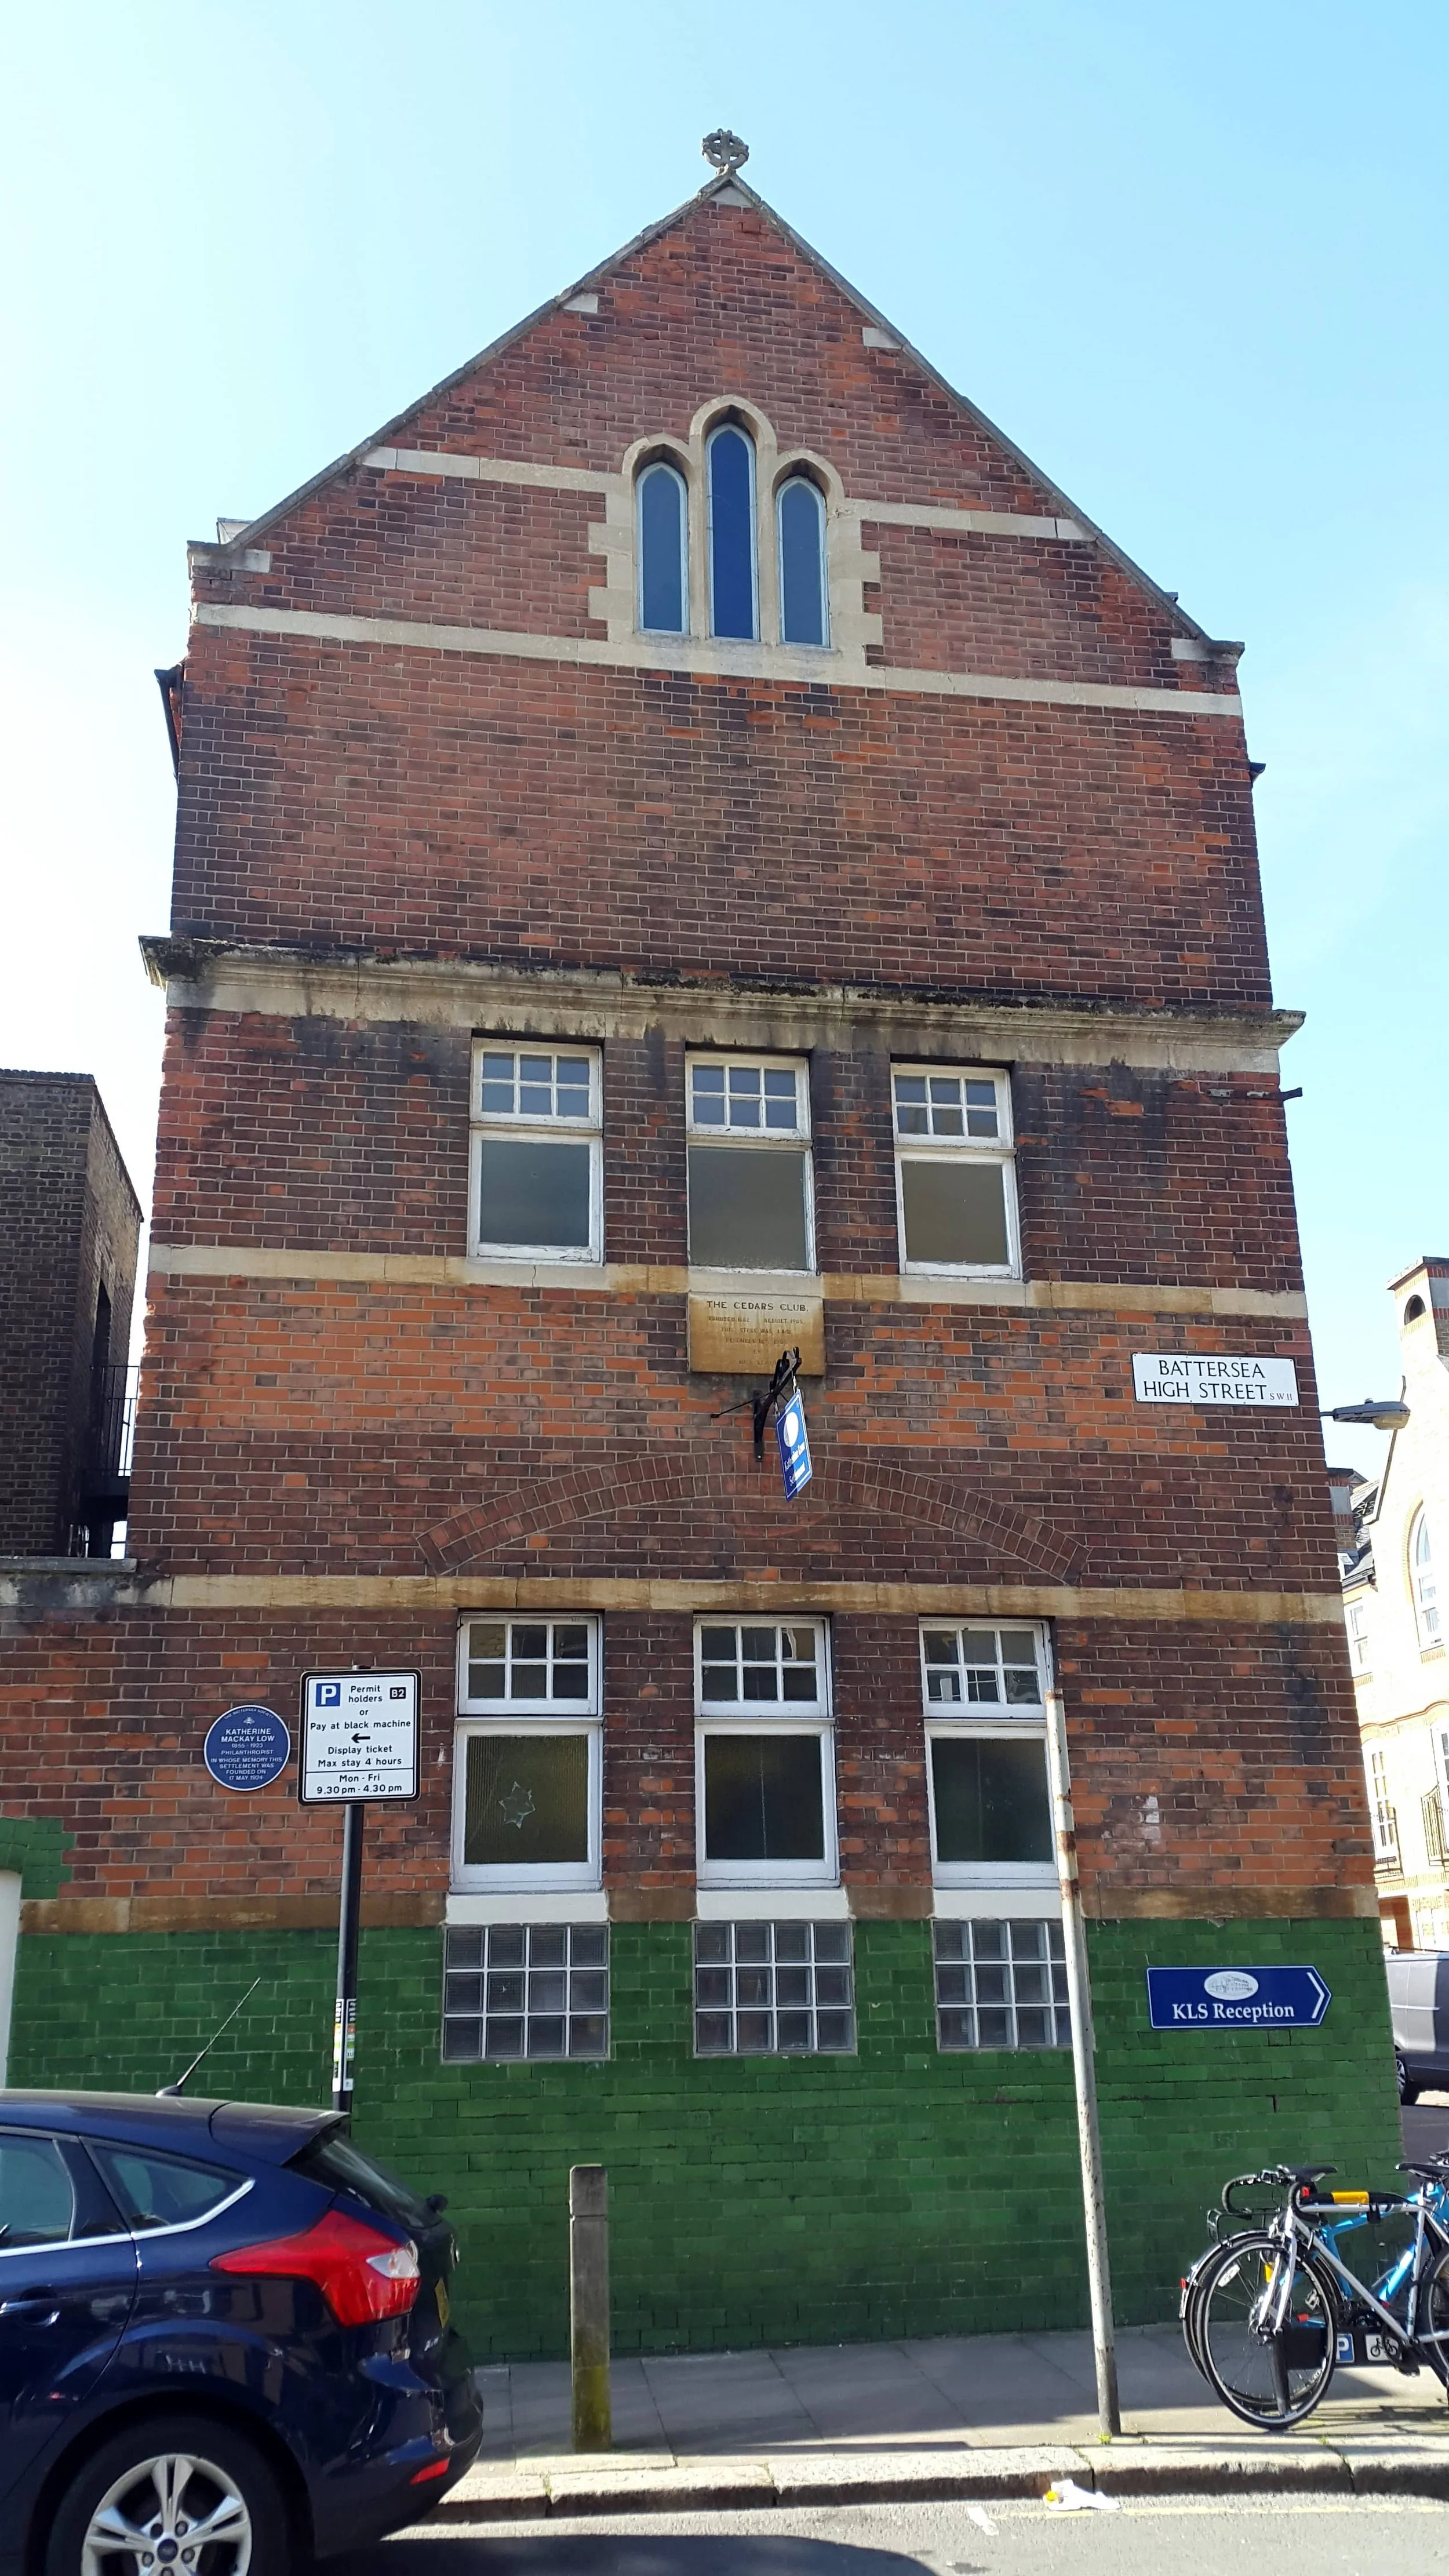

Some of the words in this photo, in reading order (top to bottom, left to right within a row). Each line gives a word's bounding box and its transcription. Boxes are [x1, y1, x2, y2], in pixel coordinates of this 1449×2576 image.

[707, 1301, 727, 1309] THE
[734, 1302, 774, 1311] CEDARS
[780, 1304, 809, 1312] CLUB.
[1159, 1360, 1266, 1378] BATTERSEA
[1144, 1381, 1190, 1398] HIGH
[1199, 1382, 1268, 1400] STREET
[321, 1685, 337, 1705] P
[351, 1685, 381, 1693] Permit
[391, 1689, 405, 1698] B2
[348, 1695, 383, 1703] holders
[310, 1722, 326, 1731] Pay
[344, 1721, 369, 1729] black
[373, 1719, 411, 1728] machine
[328, 1746, 362, 1755] Display
[366, 1745, 392, 1753] ticket
[318, 1759, 337, 1767] Max
[341, 1759, 361, 1768] stay
[365, 1758, 372, 1766] 4
[376, 1758, 402, 1766] hours
[339, 1774, 359, 1782] Mon
[368, 1773, 380, 1781] Fri
[316, 1786, 340, 1795] 9.30
[341, 1787, 355, 1795] pm
[363, 1785, 385, 1793] 4.30
[388, 1785, 402, 1793] pm
[1172, 2003, 1208, 2020] KLS
[1212, 2001, 1295, 2023] Reception
[1336, 2337, 1349, 2361] P
